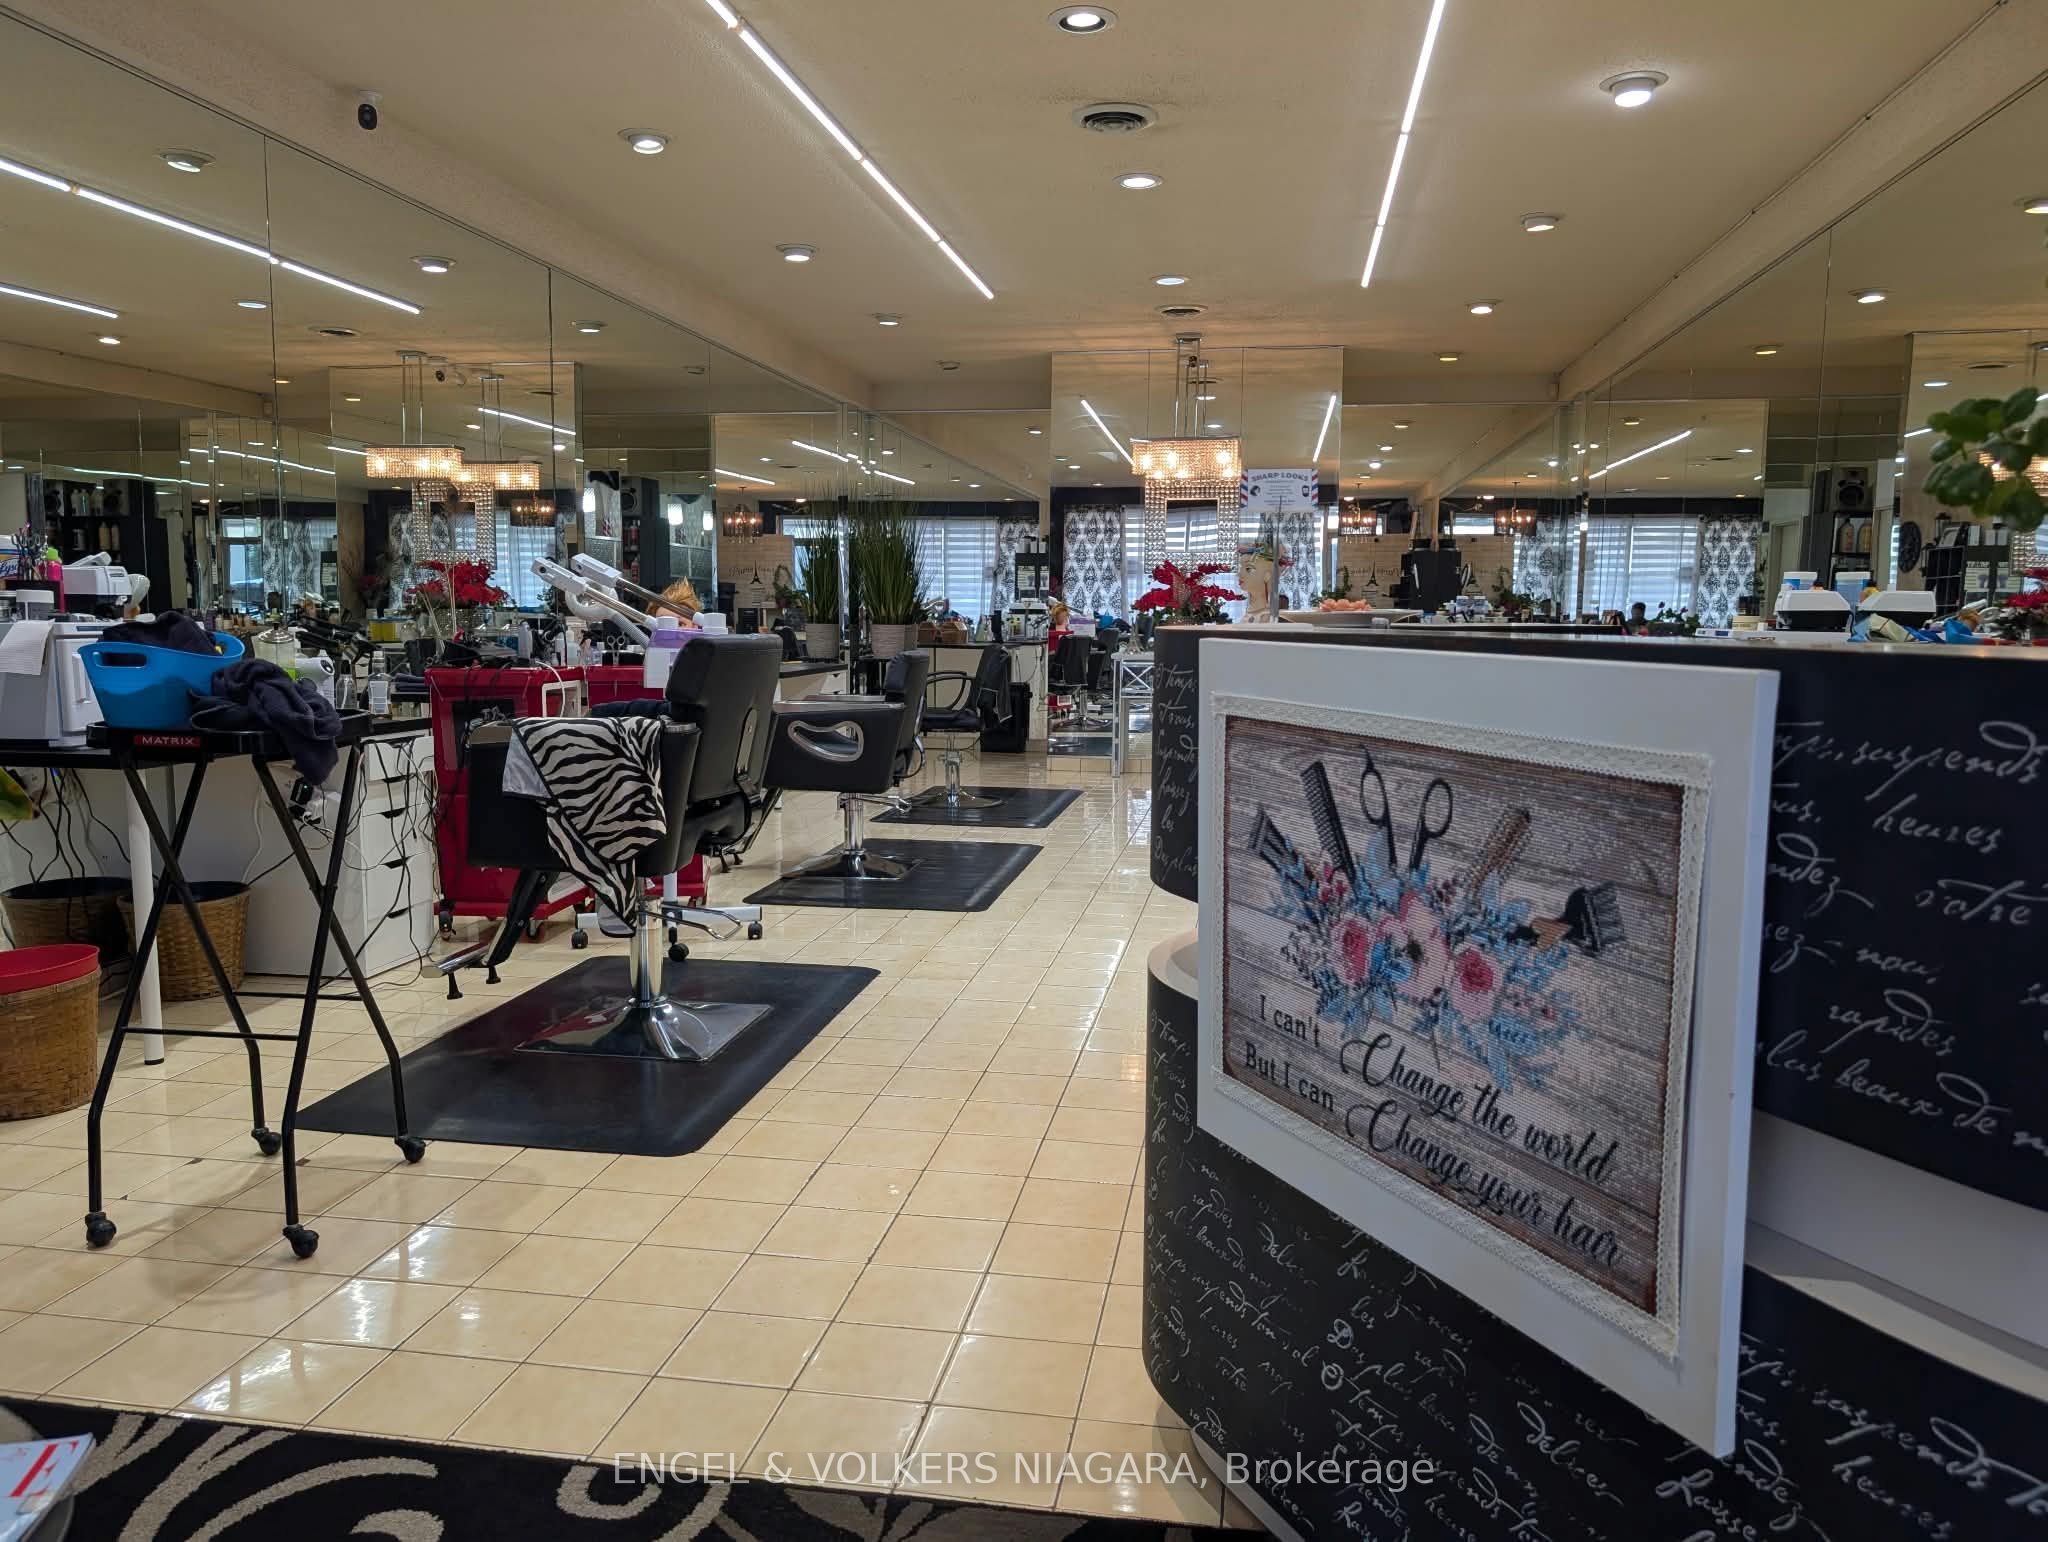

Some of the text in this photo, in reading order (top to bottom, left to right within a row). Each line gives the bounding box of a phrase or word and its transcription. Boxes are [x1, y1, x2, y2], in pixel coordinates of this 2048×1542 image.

[1251, 472, 1279, 481] SHARP
[142, 735, 194, 745] MATRIX
[1259, 994, 1620, 1184] I can't Change the world
[1244, 1041, 1624, 1268] But I can Change your hair
